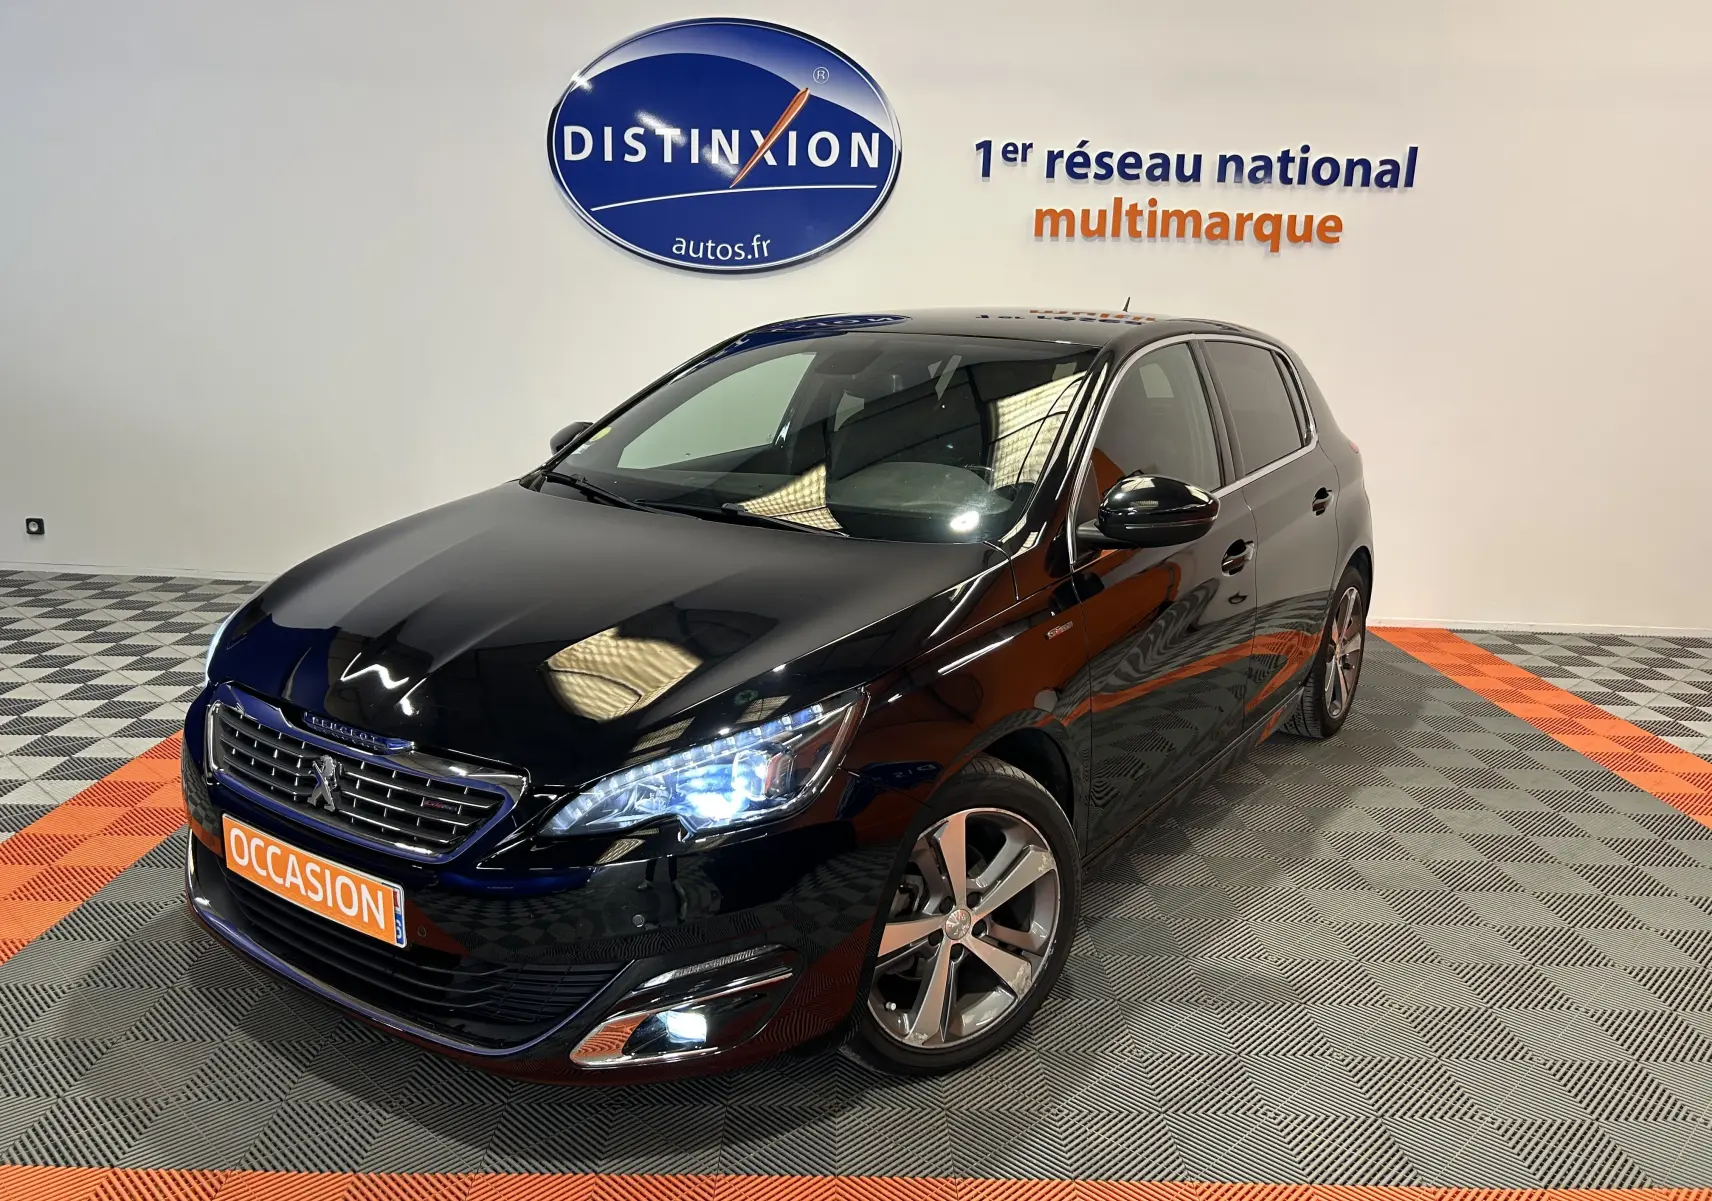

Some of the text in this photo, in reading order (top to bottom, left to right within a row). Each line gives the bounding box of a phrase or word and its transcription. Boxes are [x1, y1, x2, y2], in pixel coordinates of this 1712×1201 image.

[562, 125, 880, 169] DISTINXION
[975, 139, 1418, 188] 1er réseau national
[671, 234, 771, 261] autos.fr
[1034, 197, 1343, 253] multimarque
[229, 827, 386, 931] OCCASION
